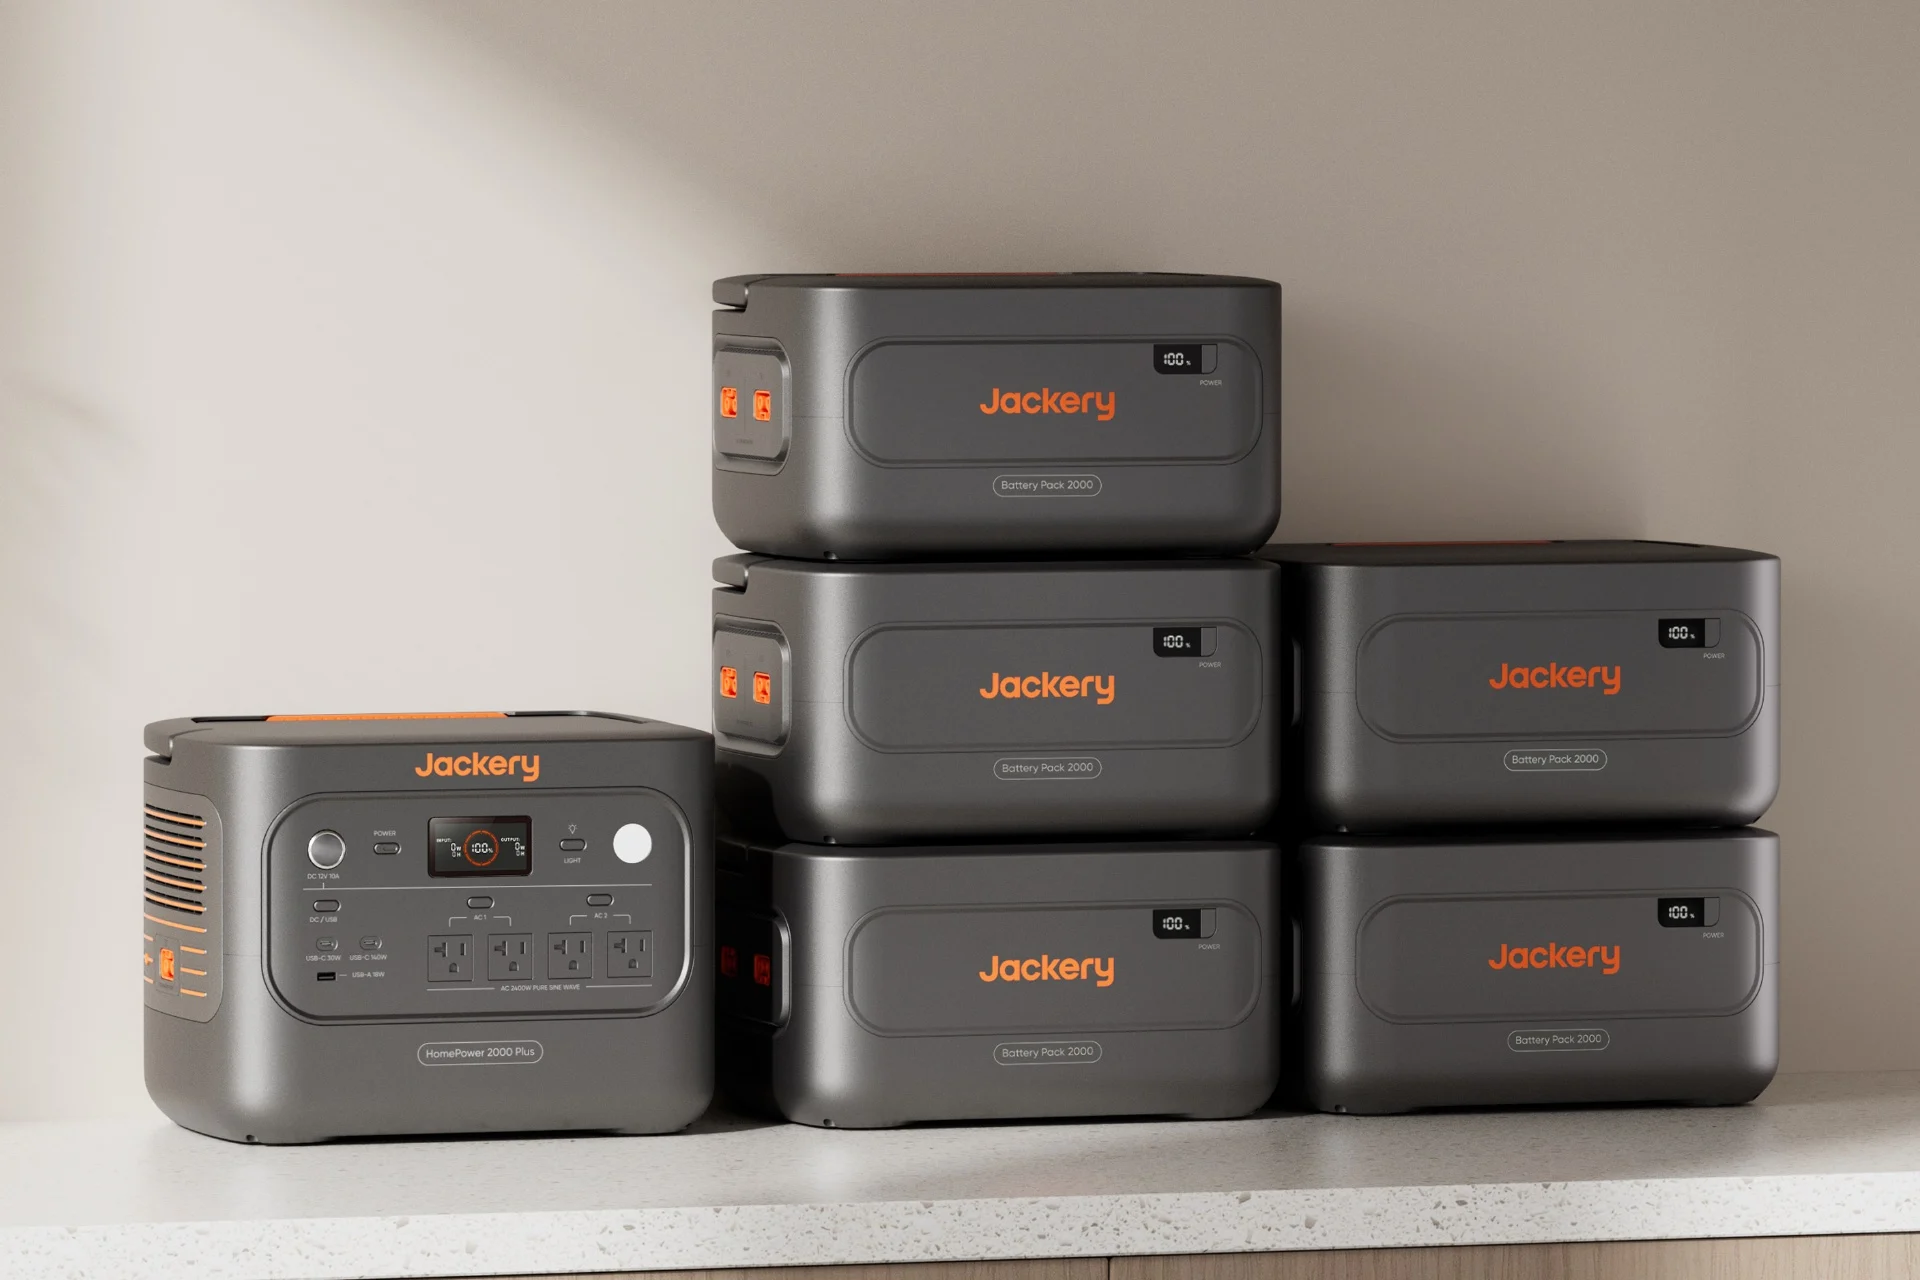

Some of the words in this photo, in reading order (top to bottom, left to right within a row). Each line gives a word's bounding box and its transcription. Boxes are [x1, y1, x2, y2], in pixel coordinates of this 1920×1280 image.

[1200, 379, 1222, 387] POWER
[980, 388, 1115, 421] Jackery
[1002, 481, 1038, 491] Battery
[1041, 480, 1064, 489] Pack
[1067, 480, 1093, 489] 2000
[1703, 652, 1725, 660] POWER
[1199, 661, 1221, 669] POWER
[1489, 662, 1621, 695] Jackery
[980, 672, 1115, 705] Jackery
[1512, 755, 1547, 765] Battery
[1549, 755, 1572, 763] Pack
[1574, 754, 1599, 763] 2000
[415, 752, 539, 782] Jackery
[1002, 764, 1038, 774] Battery
[1041, 763, 1064, 772] Pack
[1068, 762, 1093, 771] 2000
[374, 829, 396, 837] POWER
[307, 872, 316, 880] DC
[318, 872, 328, 880] 12V
[329, 872, 339, 880] 10A
[325, 915, 337, 923] USB
[1703, 931, 1724, 939] POWER
[1198, 943, 1220, 951] POWER
[306, 954, 326, 962] USB-C
[1488, 942, 1620, 975] Jackery
[979, 955, 1114, 987] Jackery
[501, 984, 509, 992] AC
[511, 984, 532, 992] 2400W
[533, 984, 548, 992] PURE
[549, 983, 561, 991] SINE
[563, 983, 580, 991] WAVE
[1516, 1036, 1550, 1045] Battery
[1553, 1035, 1575, 1043] Pack
[1577, 1034, 1601, 1043] 2000
[426, 1049, 484, 1058] HomePower
[487, 1048, 513, 1057] 2000
[515, 1047, 535, 1056] Plus
[1002, 1049, 1039, 1059] Battery
[1042, 1048, 1065, 1056] Pack
[1068, 1047, 1093, 1056] 2000
